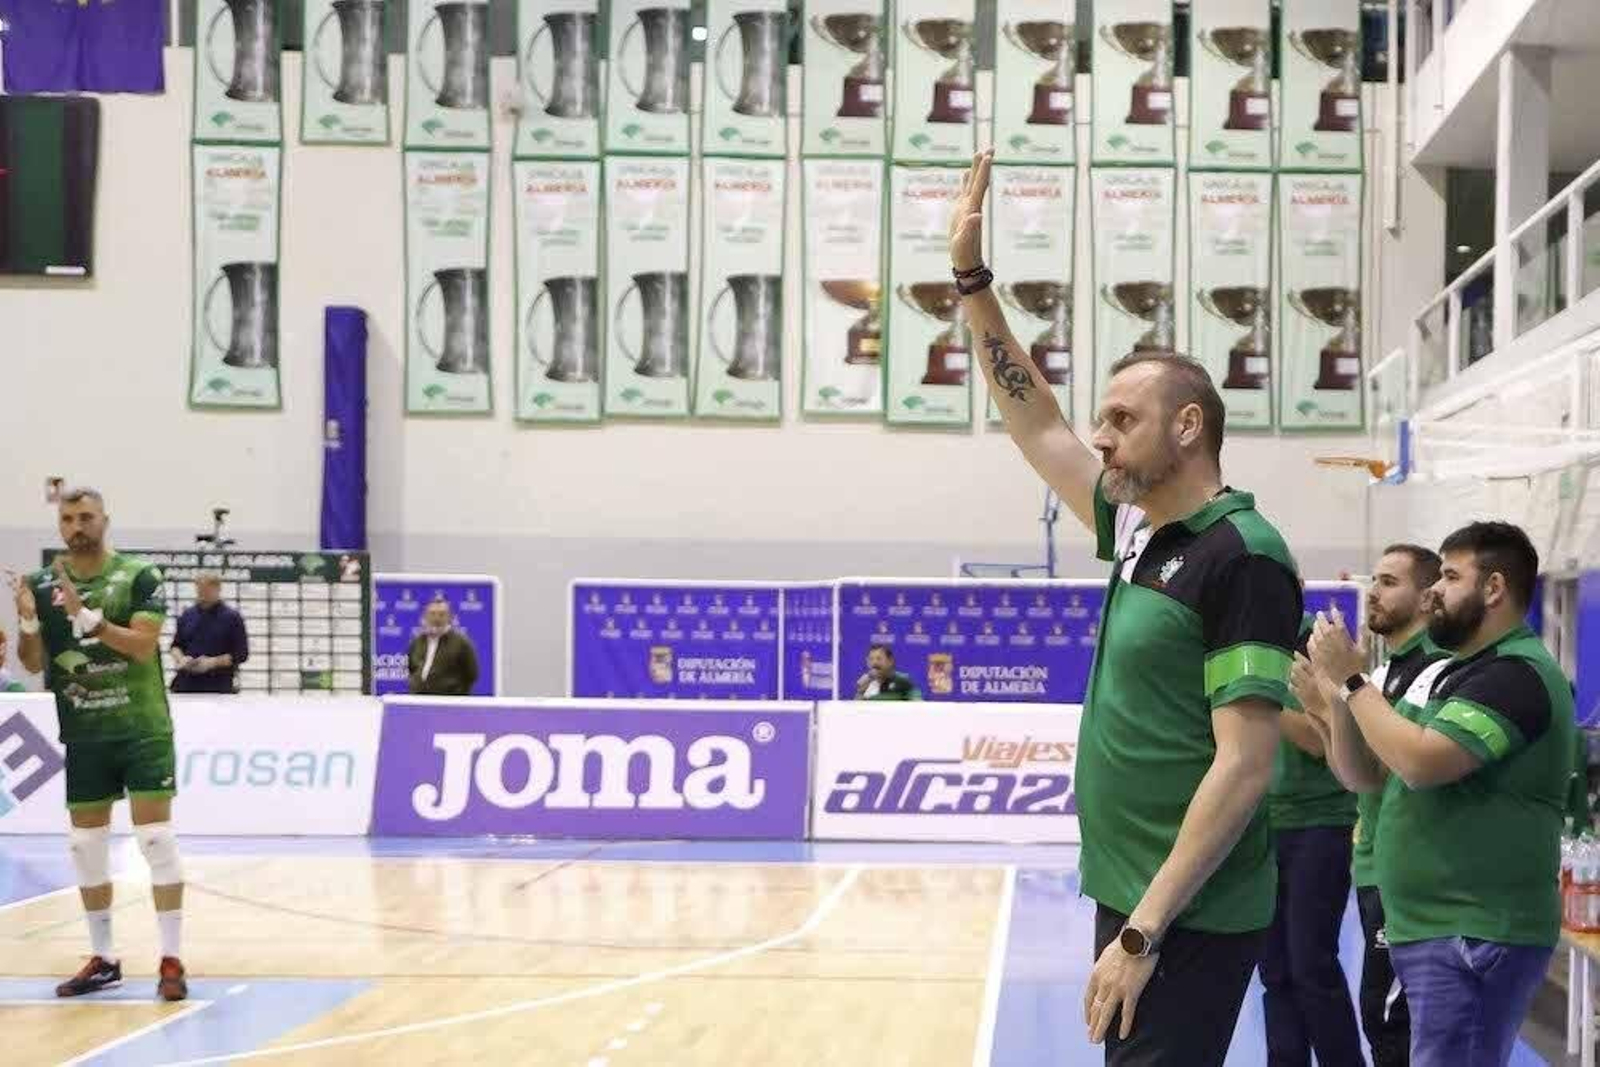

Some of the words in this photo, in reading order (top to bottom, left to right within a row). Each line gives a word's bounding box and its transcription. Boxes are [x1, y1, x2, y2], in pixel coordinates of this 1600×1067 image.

[181, 750, 357, 788] rosan
[962, 735, 1075, 768] Viajes
[823, 758, 1077, 815] alcaz
